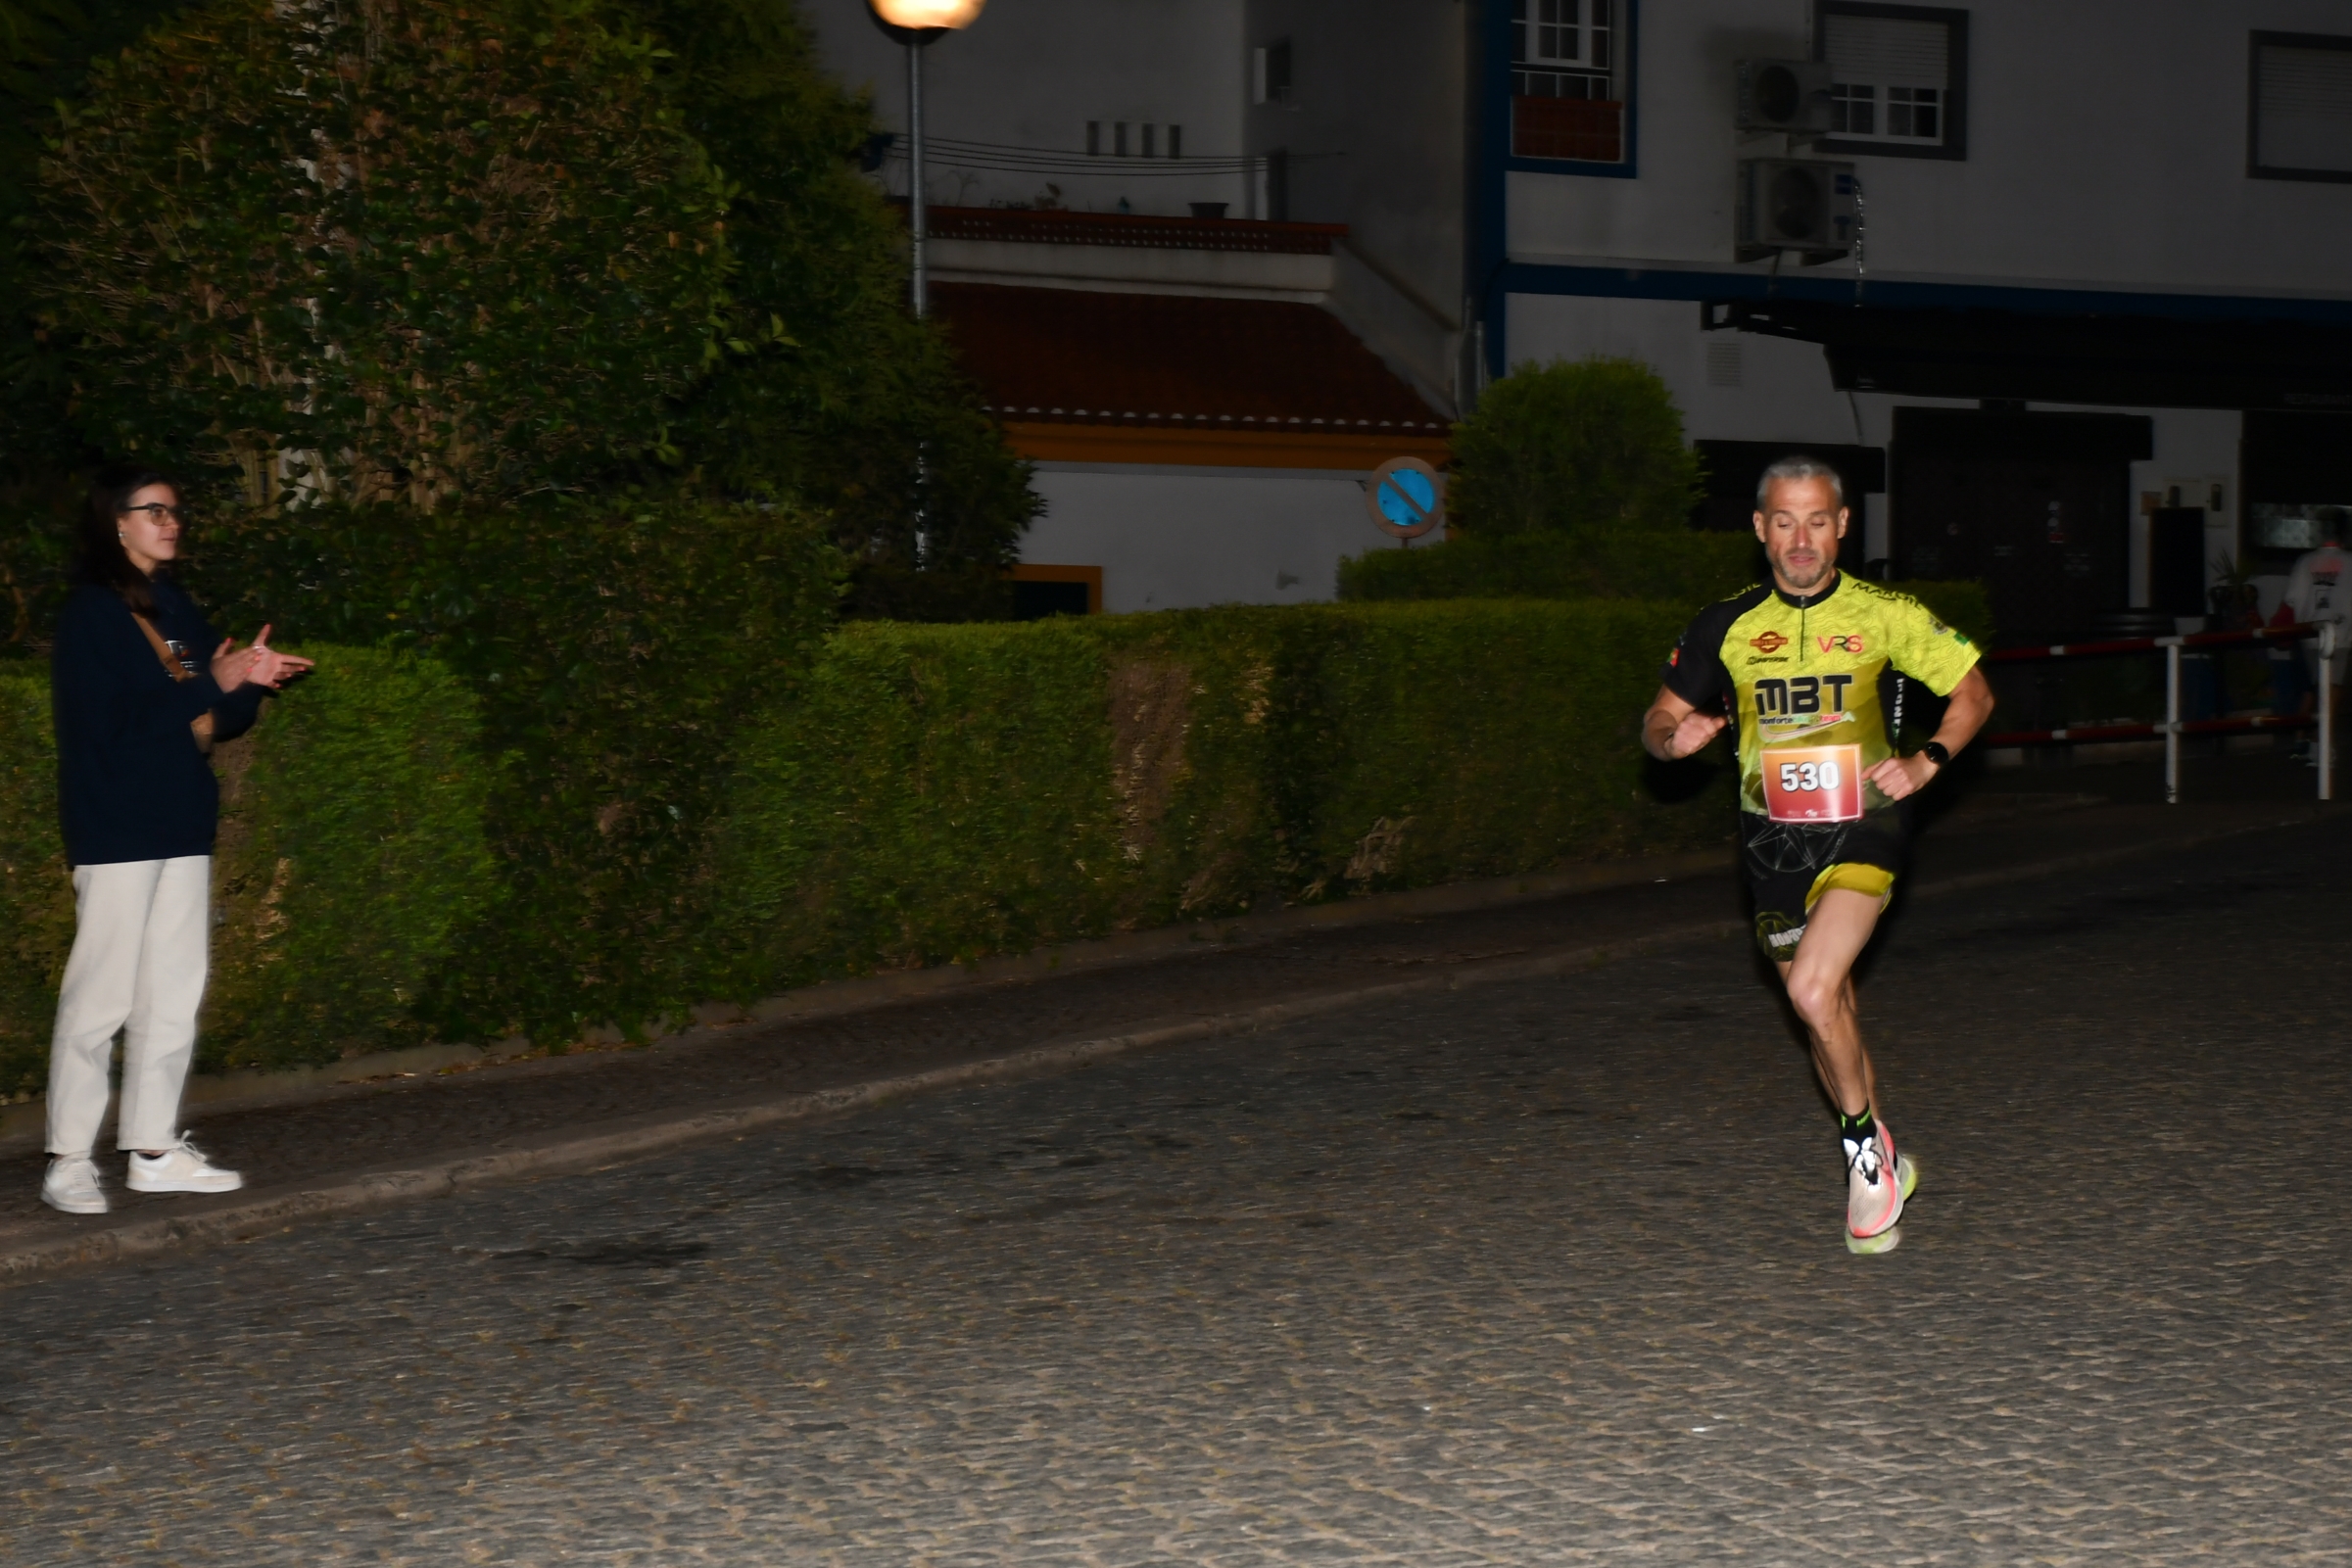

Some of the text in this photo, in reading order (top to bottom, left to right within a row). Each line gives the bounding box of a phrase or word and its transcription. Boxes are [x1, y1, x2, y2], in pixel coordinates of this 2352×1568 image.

[1817, 635, 1863, 653] VRS
[1753, 674, 1853, 716] MBT
[1780, 761, 1840, 792] 530
